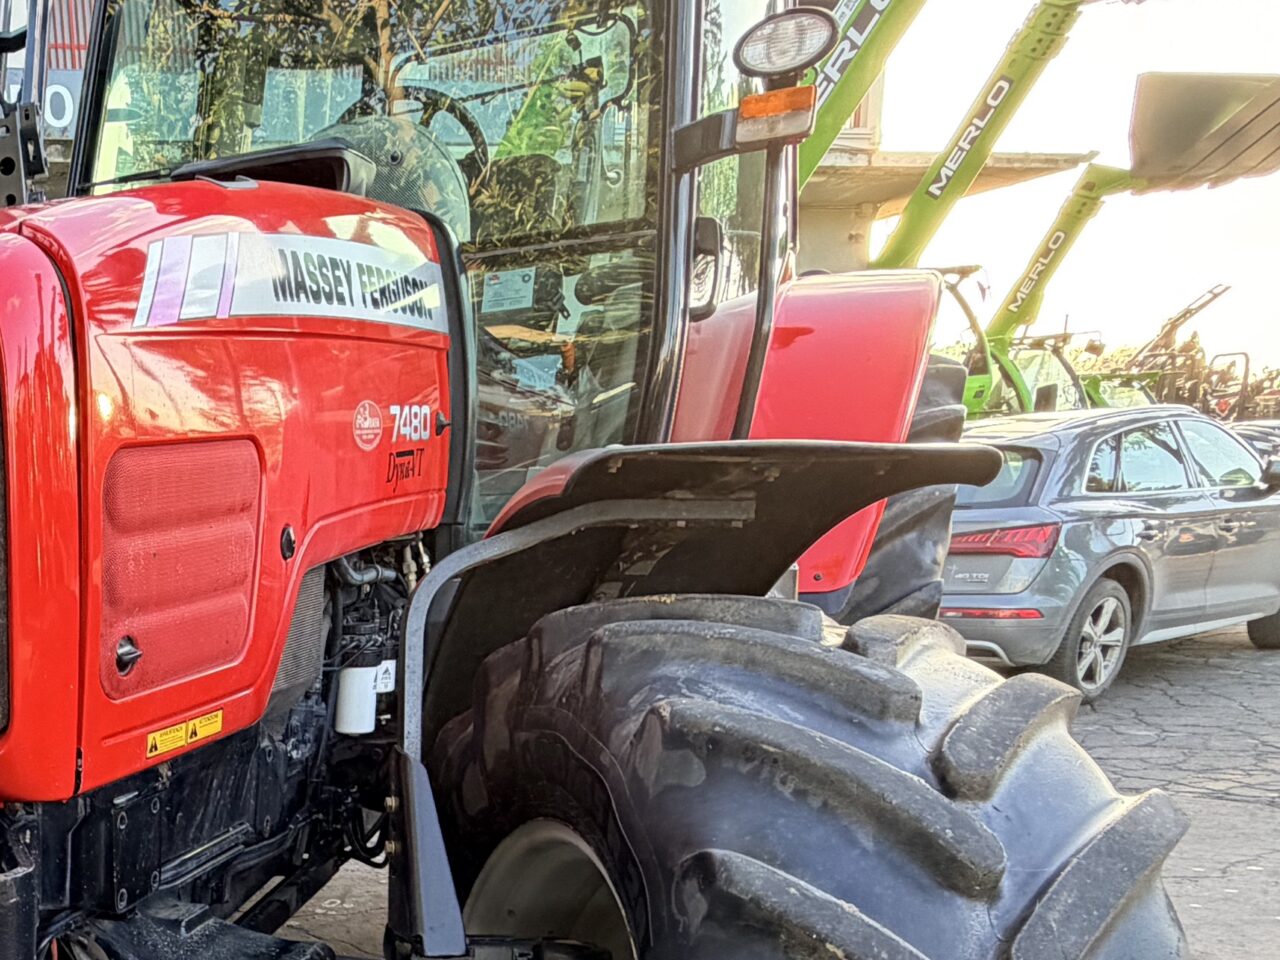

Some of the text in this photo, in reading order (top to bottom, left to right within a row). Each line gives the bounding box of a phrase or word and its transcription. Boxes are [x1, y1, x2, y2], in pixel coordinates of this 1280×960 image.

[816, 0, 890, 109] ERL
[927, 79, 1010, 196] MERLO
[272, 248, 354, 307] MASSEY
[356, 262, 433, 320] FERGUSON
[1008, 231, 1066, 312] MERLO
[389, 404, 430, 444] 7480
